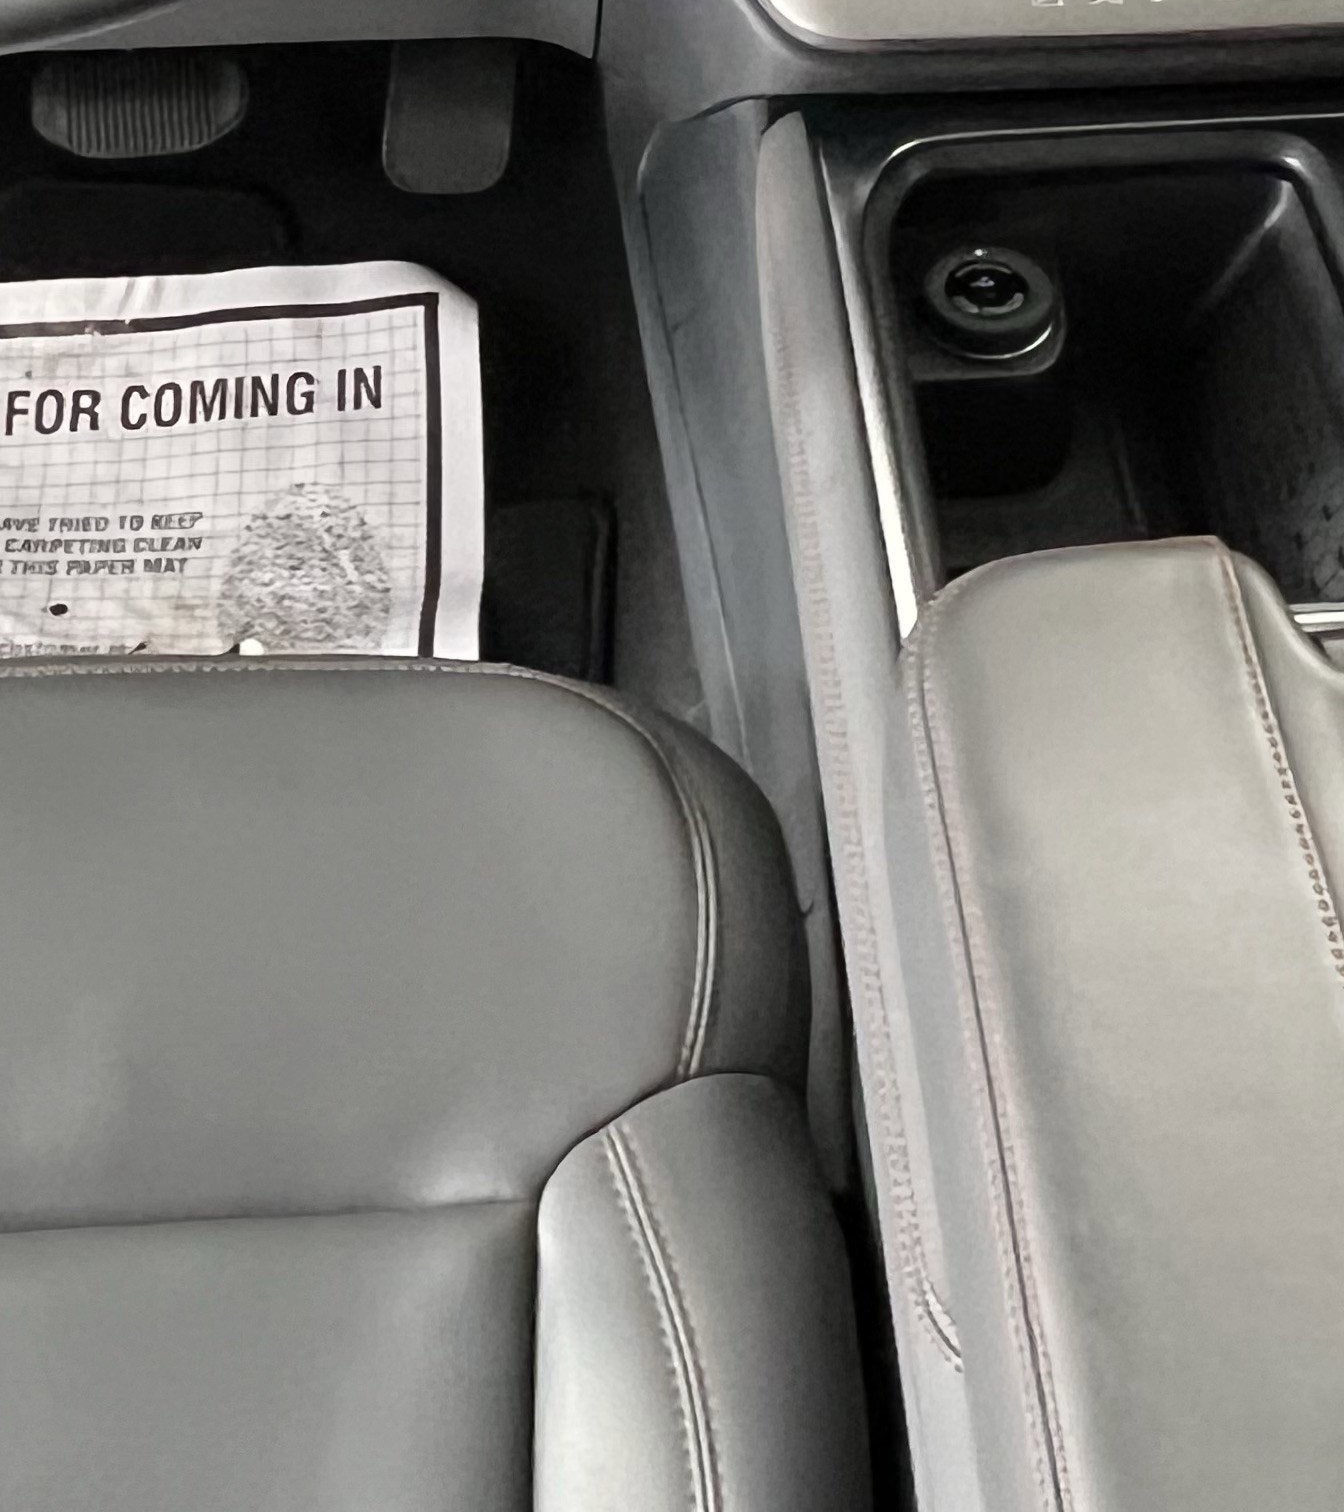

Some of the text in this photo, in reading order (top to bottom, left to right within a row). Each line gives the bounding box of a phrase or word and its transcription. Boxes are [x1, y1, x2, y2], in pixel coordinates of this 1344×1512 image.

[3, 388, 102, 437] FOR
[119, 371, 316, 431] COMING
[336, 365, 383, 411] IN
[49, 515, 110, 533] TRIED
[118, 514, 145, 531] TO
[4, 538, 127, 555] CARPETING
[133, 536, 204, 554] CLEAN
[9, 559, 60, 576] THIS
[65, 558, 136, 576] PAPER
[143, 557, 189, 574] MAT
